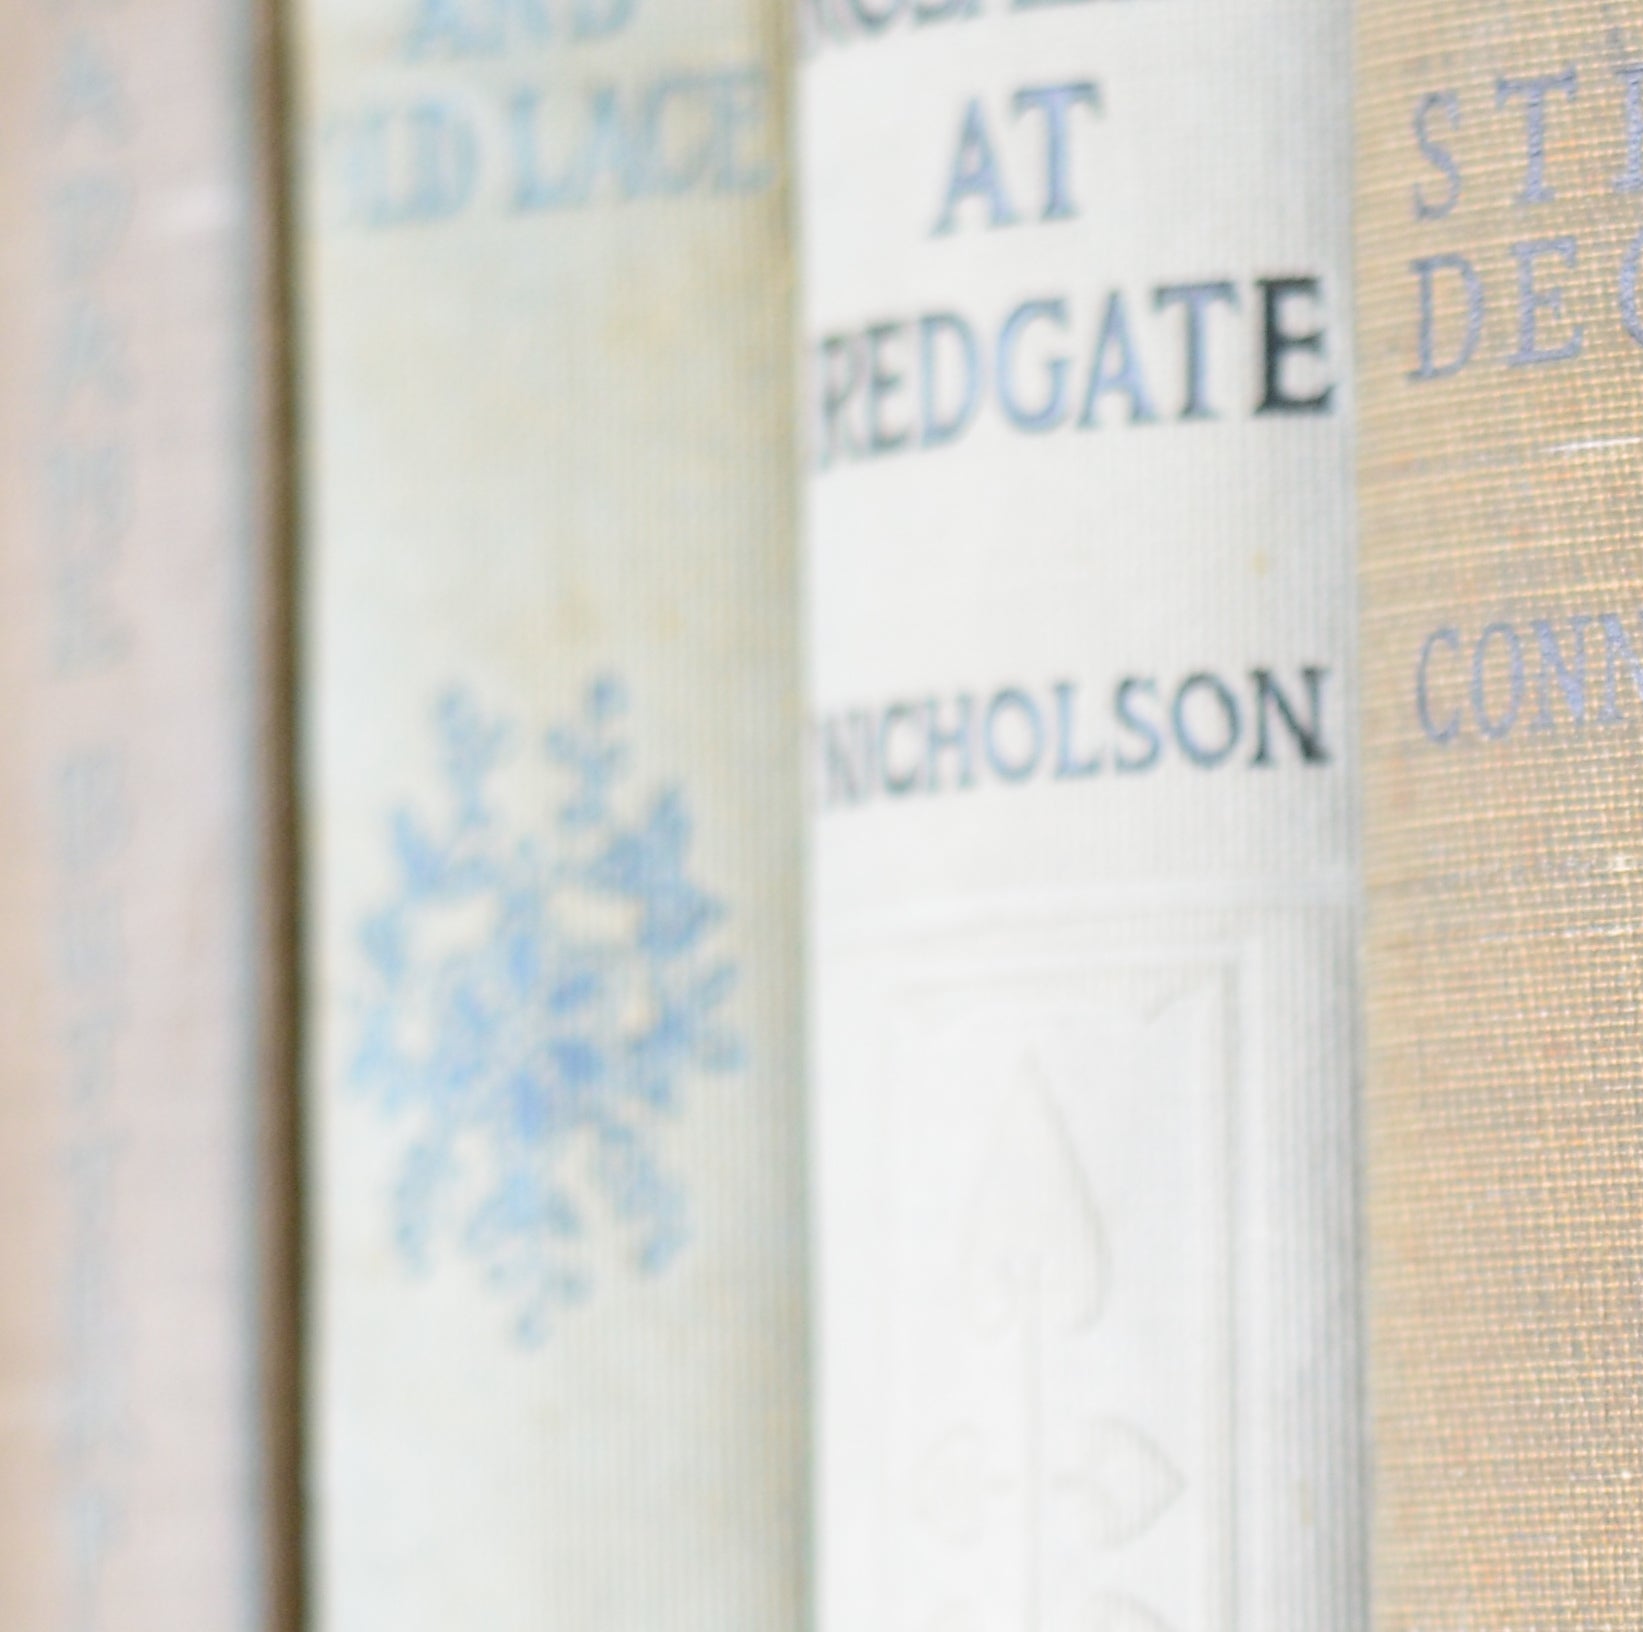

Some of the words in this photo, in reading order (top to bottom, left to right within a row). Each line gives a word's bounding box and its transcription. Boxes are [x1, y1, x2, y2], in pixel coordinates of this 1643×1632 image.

[928, 79, 1105, 238] AT
[813, 274, 1338, 472] REDGATE
[818, 664, 1336, 808] NICHOLSON
